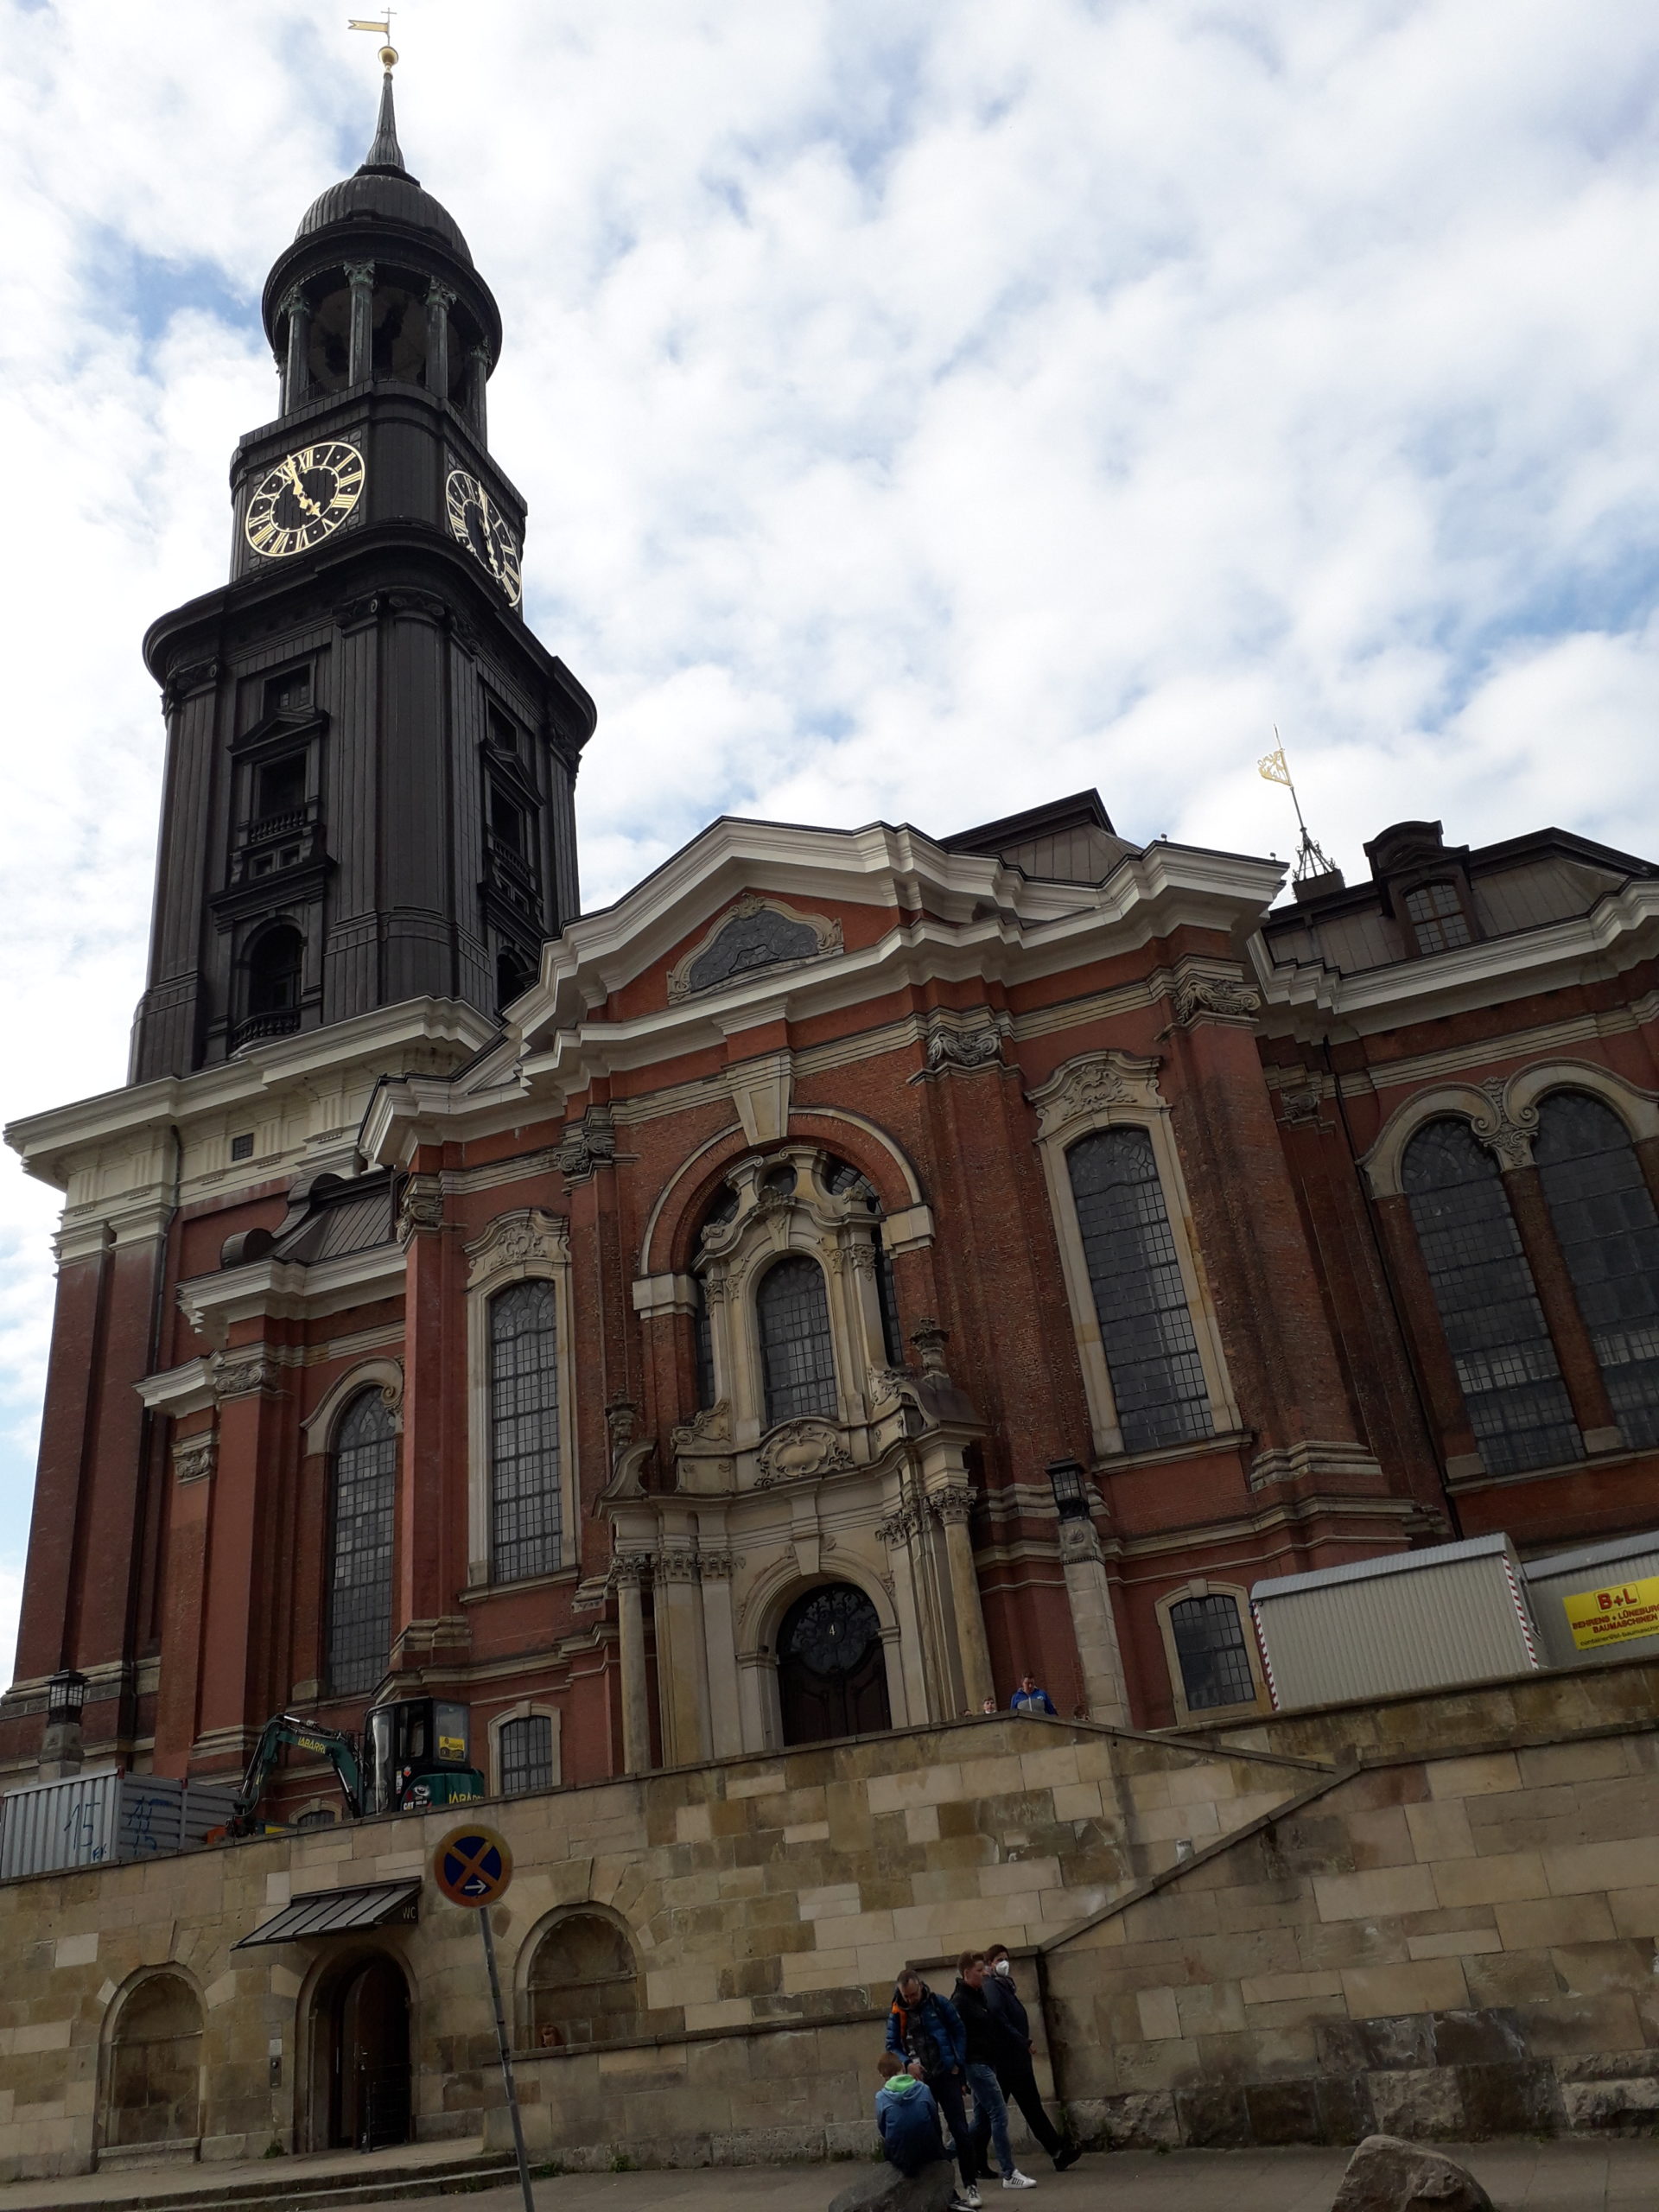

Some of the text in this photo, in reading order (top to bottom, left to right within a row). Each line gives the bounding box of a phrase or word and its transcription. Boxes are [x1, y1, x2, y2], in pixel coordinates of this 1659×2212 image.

[1597, 1588, 1637, 1610] B+L
[1572, 1615, 1610, 1630] BEHRENS
[1592, 1613, 1658, 1633] BAUMASCHINEN
[402, 1905, 416, 1919] WC
